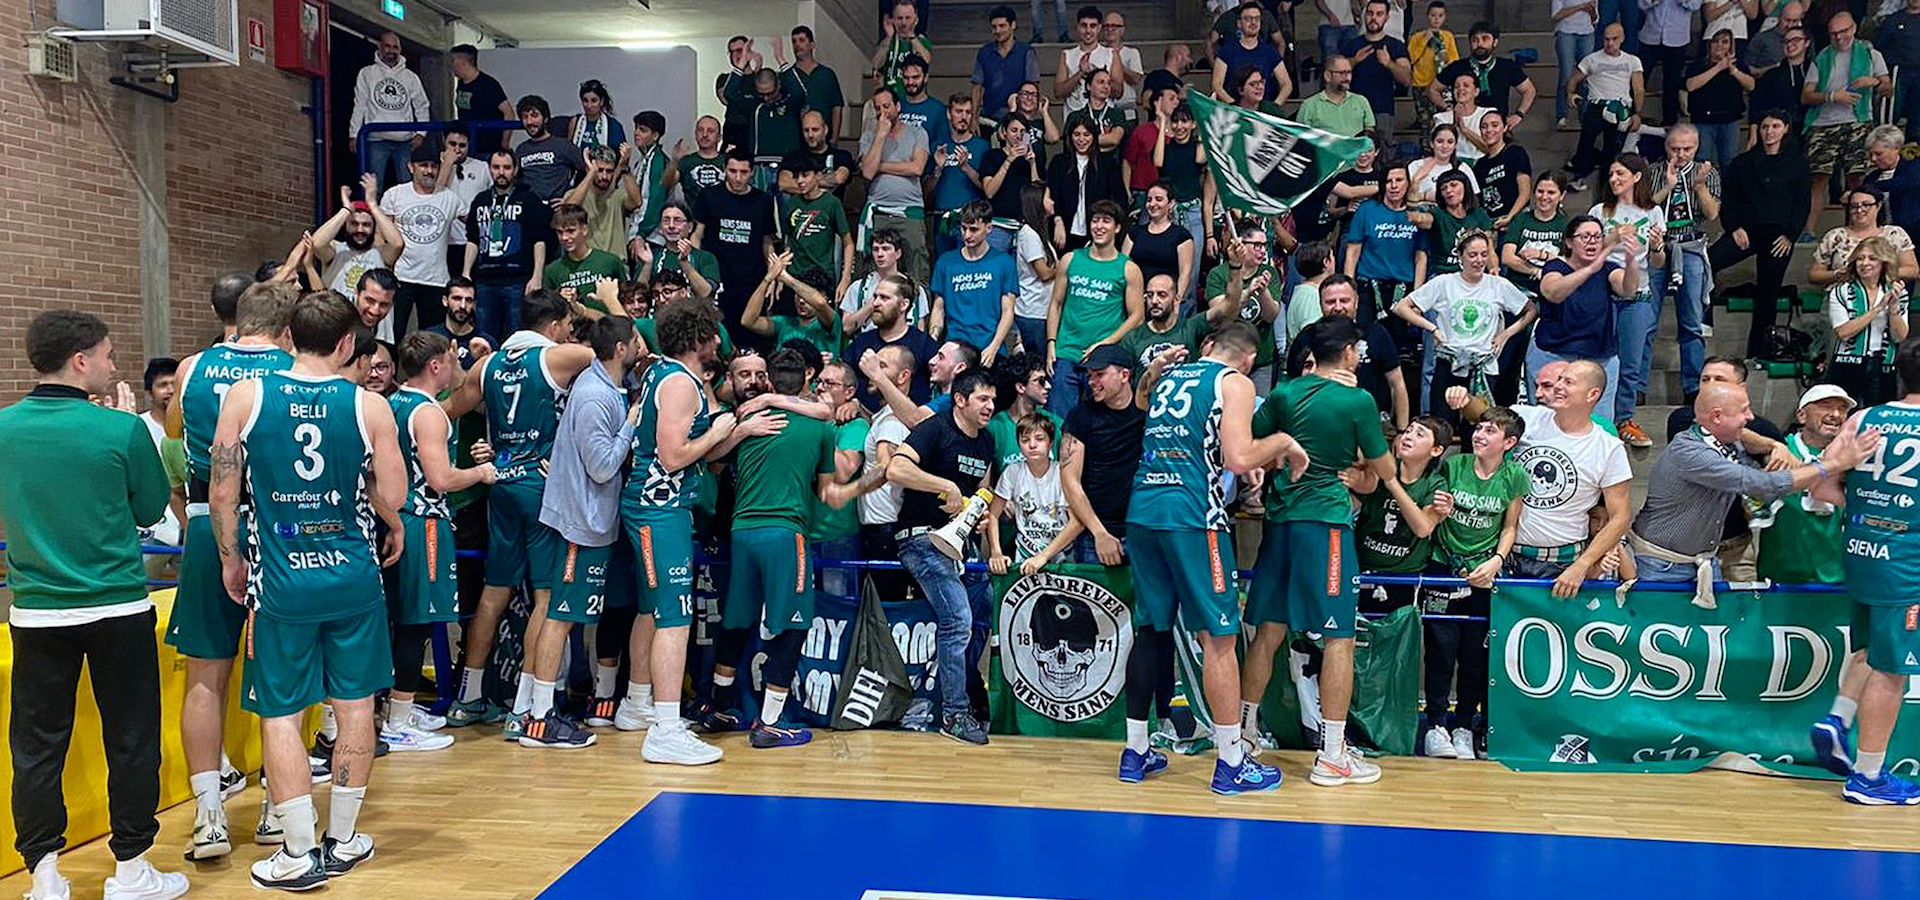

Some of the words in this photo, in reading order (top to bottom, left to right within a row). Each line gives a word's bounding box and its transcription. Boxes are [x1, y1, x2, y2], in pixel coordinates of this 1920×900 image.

[290, 404, 327, 419] BELLI
[502, 383, 521, 425] 7
[1148, 379, 1201, 420] 35
[293, 422, 325, 482] 3
[271, 490, 325, 502] Carrefour
[288, 549, 350, 570] SIENA
[1211, 549, 1225, 591] betsson
[1847, 538, 1890, 561] SIENA
[1329, 552, 1340, 594] betsson
[1003, 573, 1040, 609] LIVE
[1043, 572, 1127, 619] FOREVER
[1015, 632, 1031, 648] 18
[1098, 638, 1117, 653] 71
[1503, 616, 1733, 703] OSSI
[1012, 678, 1061, 719] MENS
[1063, 690, 1116, 721] SANA
